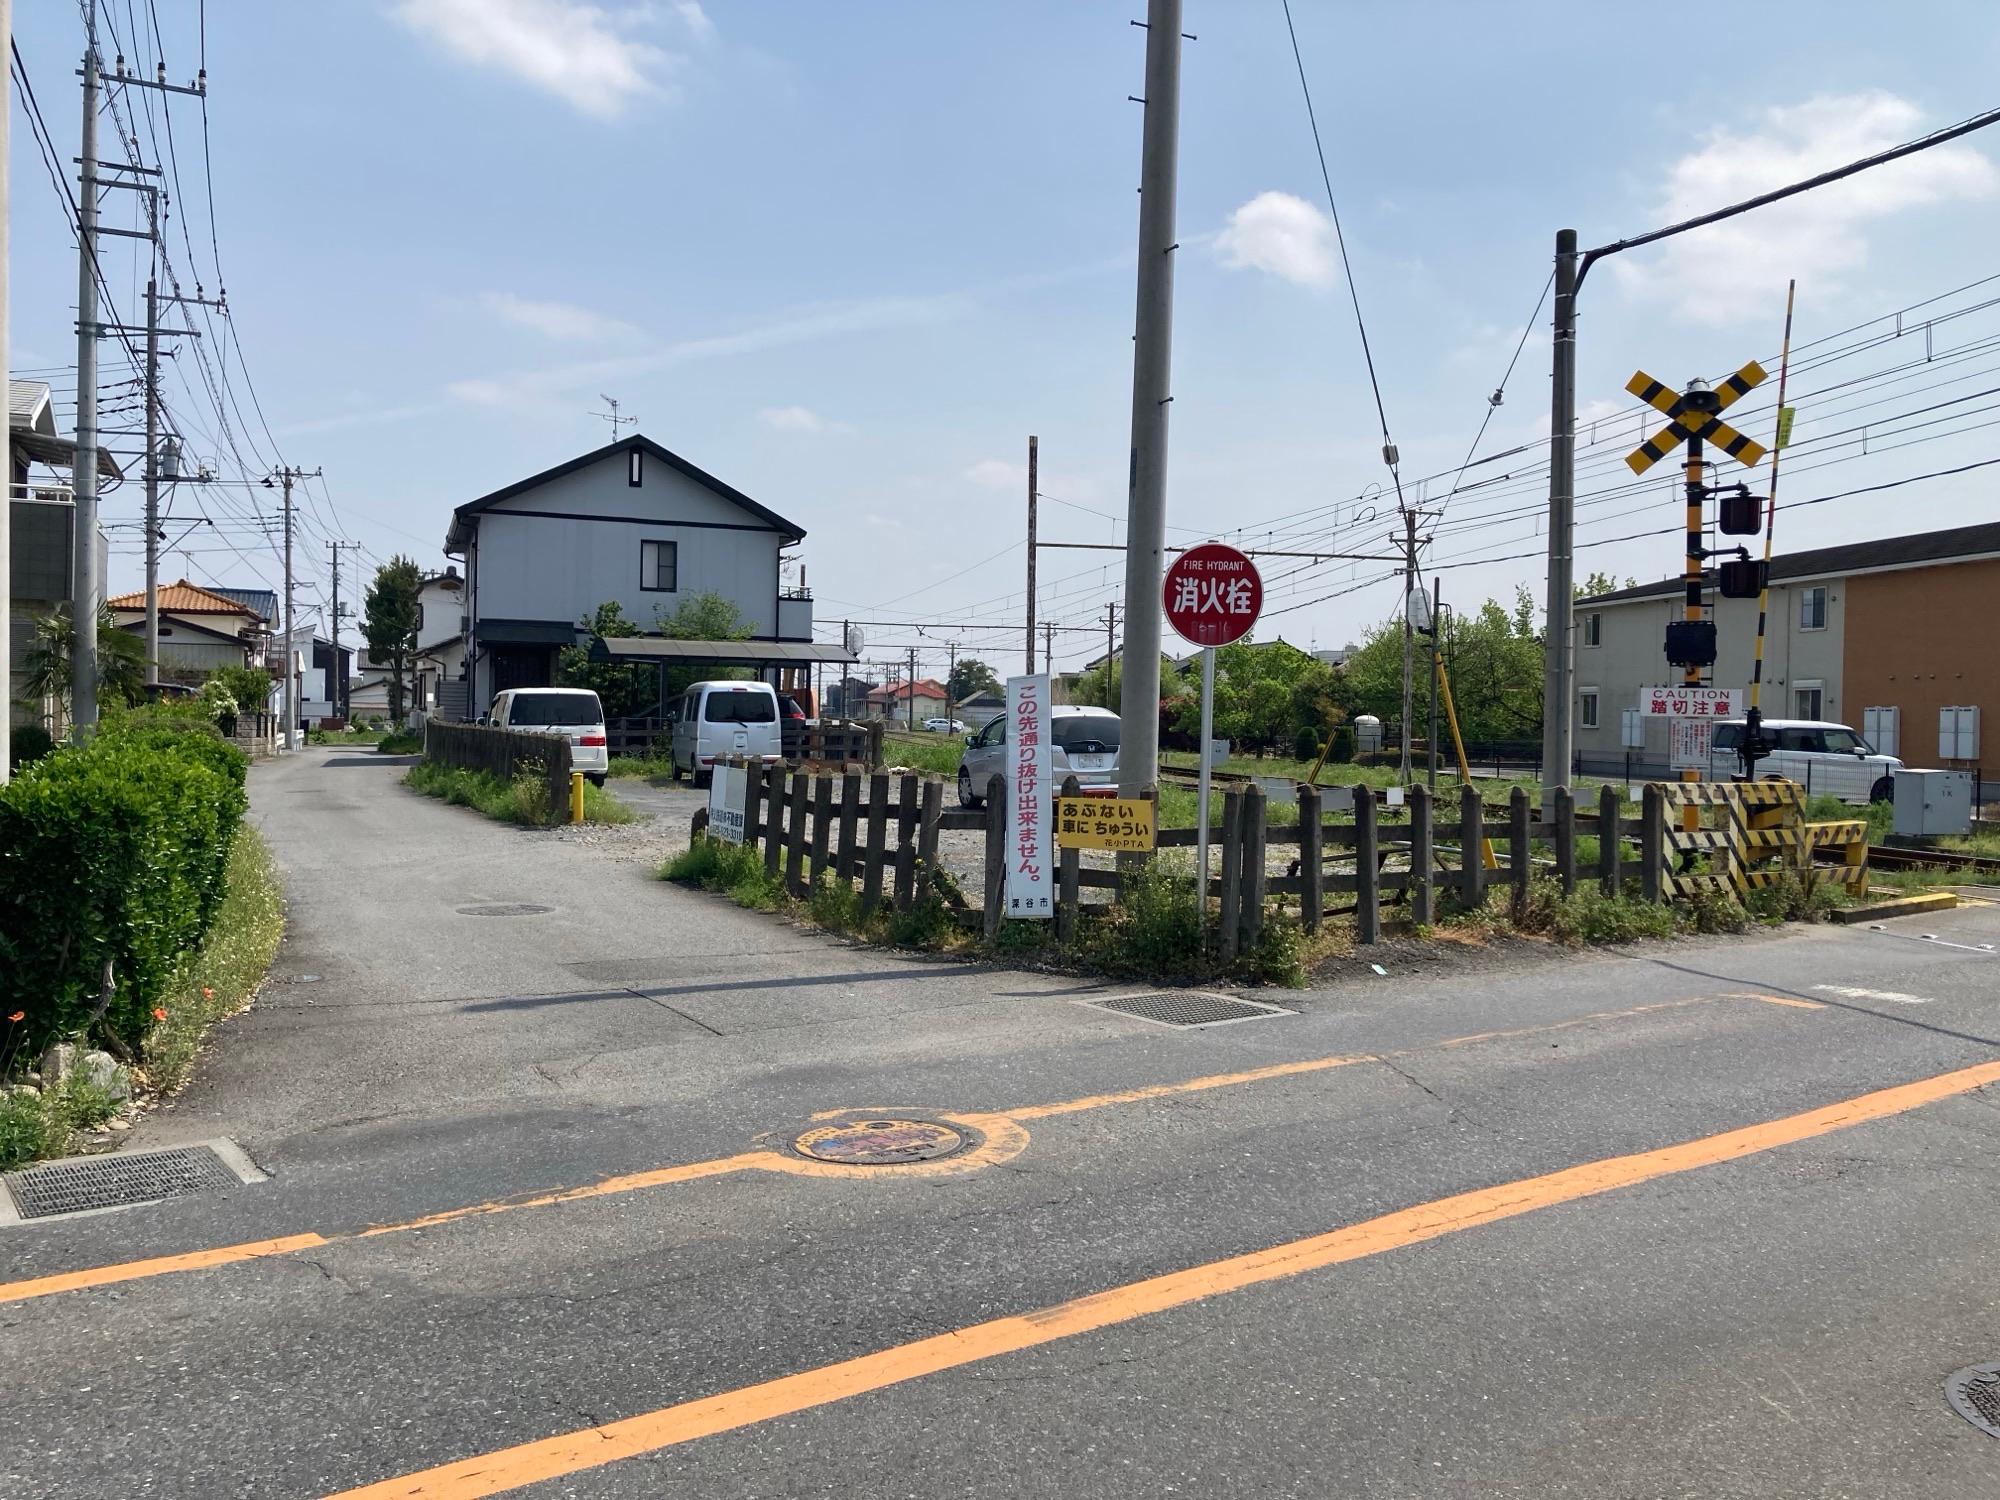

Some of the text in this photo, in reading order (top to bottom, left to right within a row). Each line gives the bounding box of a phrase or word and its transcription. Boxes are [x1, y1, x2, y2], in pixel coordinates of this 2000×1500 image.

[1183, 560, 1245, 571] FIRE HYDRANT
[1173, 577, 1253, 614] 消火栓
[1653, 690, 1730, 699] CAUTION
[1651, 700, 1731, 715] 踏切注意
[1017, 685, 1041, 882] この先通り抜け出来ません。
[1063, 803, 1134, 818] あぶない
[1105, 839, 1144, 848] 花小PTA
[1012, 897, 1048, 909] 深谷市
